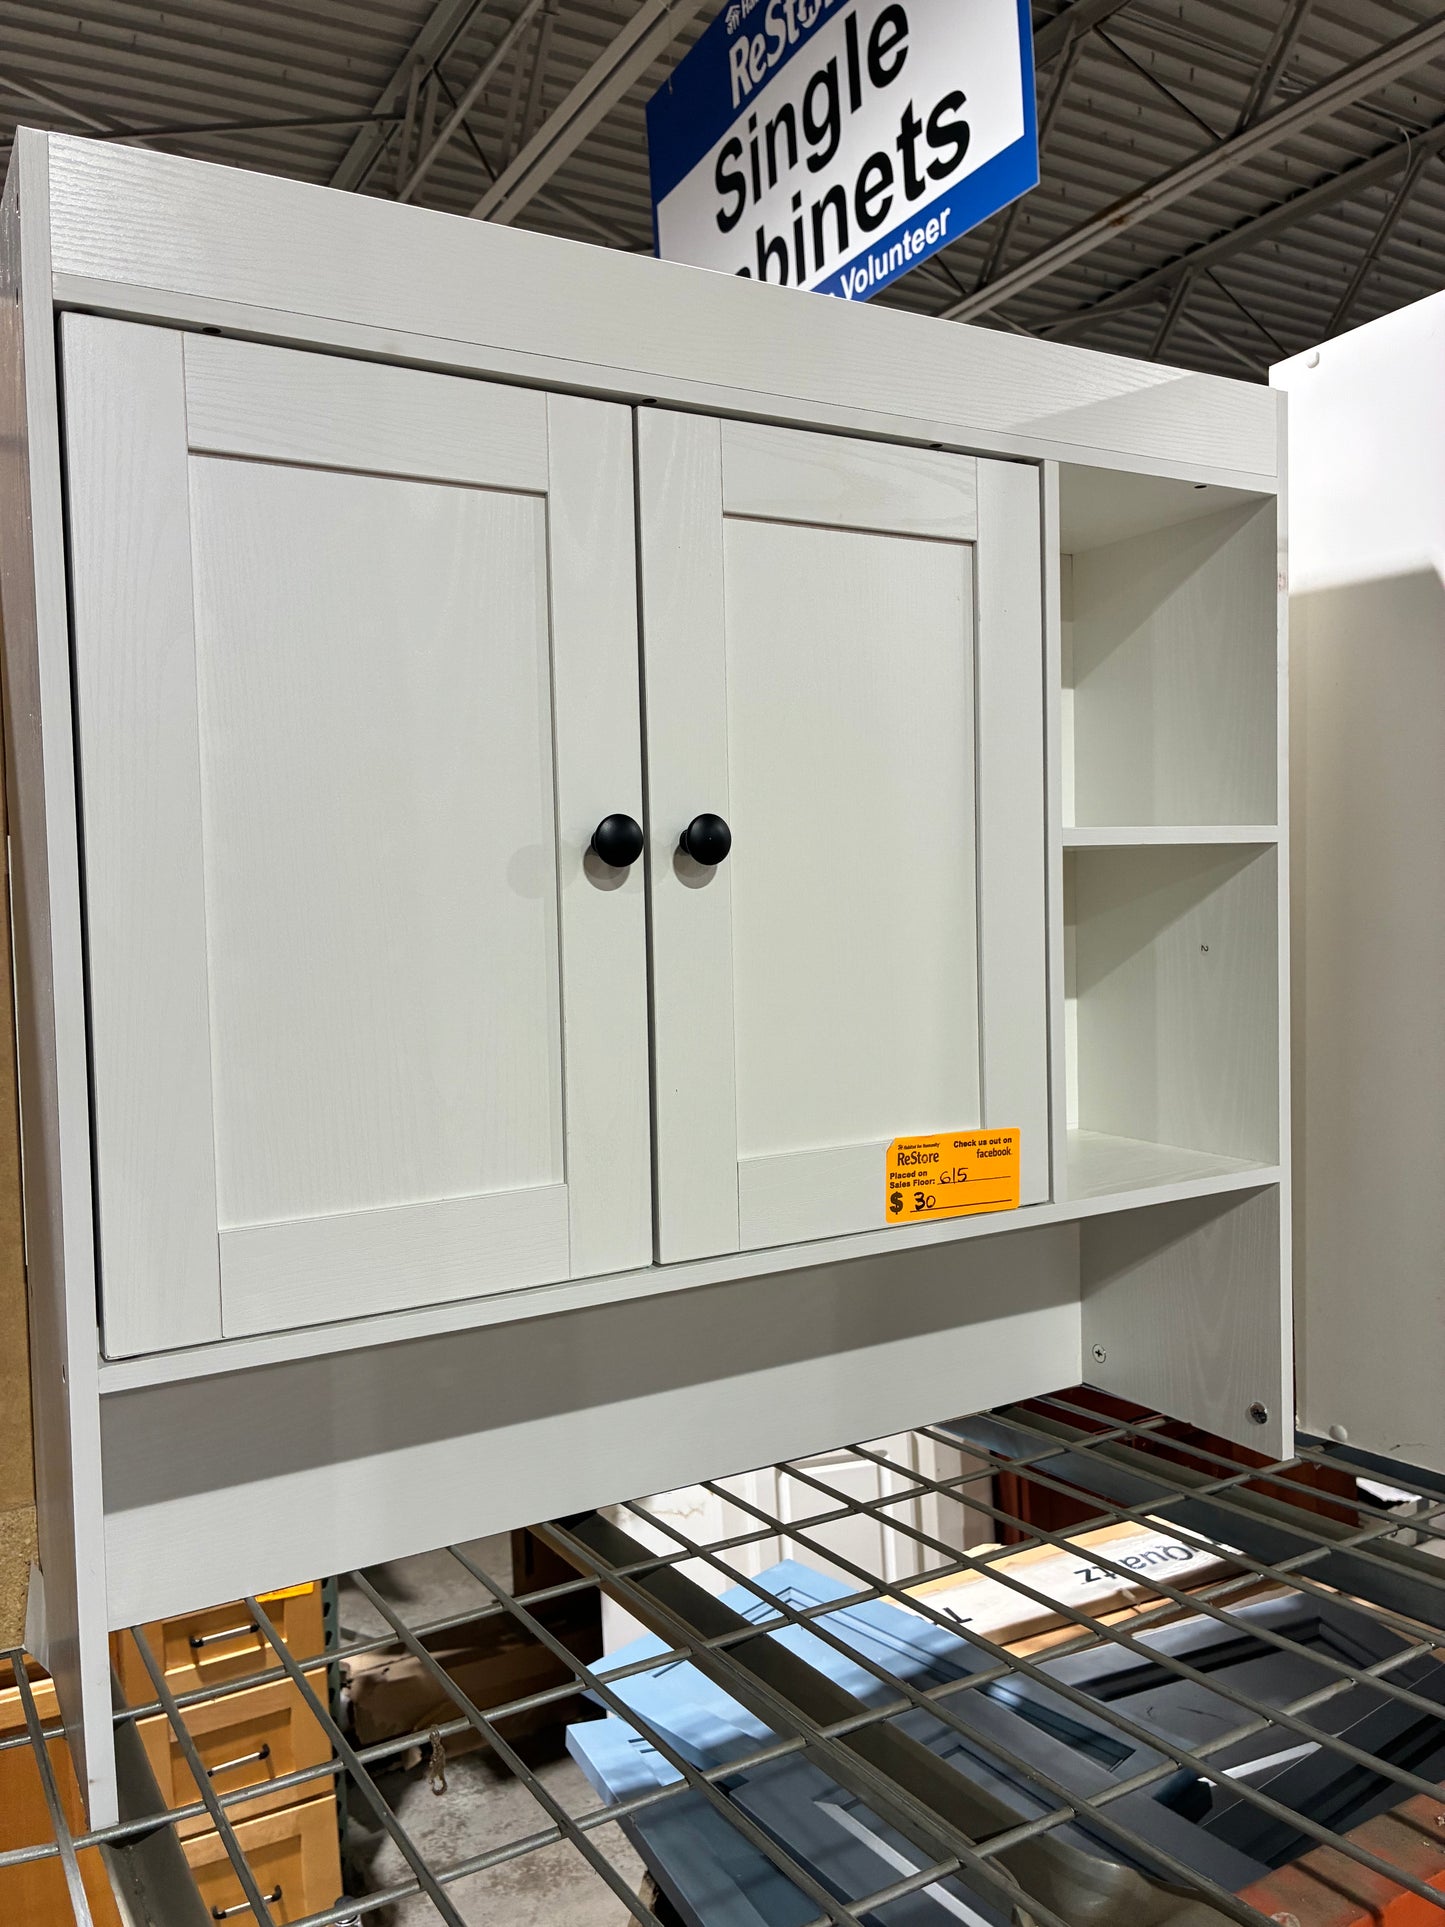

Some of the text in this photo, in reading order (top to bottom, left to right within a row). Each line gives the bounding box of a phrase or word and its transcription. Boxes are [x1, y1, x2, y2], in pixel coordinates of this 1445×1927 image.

[714, 3, 909, 234] Single
[734, 90, 970, 286] binets
[840, 207, 951, 301] Volunteer
[953, 1136, 1013, 1149] Check us out on
[897, 1150, 940, 1166] ReStore
[976, 1146, 1011, 1159] facebook
[889, 1170, 928, 1180] Placed on
[889, 1180, 911, 1189] Sales
[913, 1178, 936, 1187] Floor:
[889, 1191, 937, 1215] $ 30
